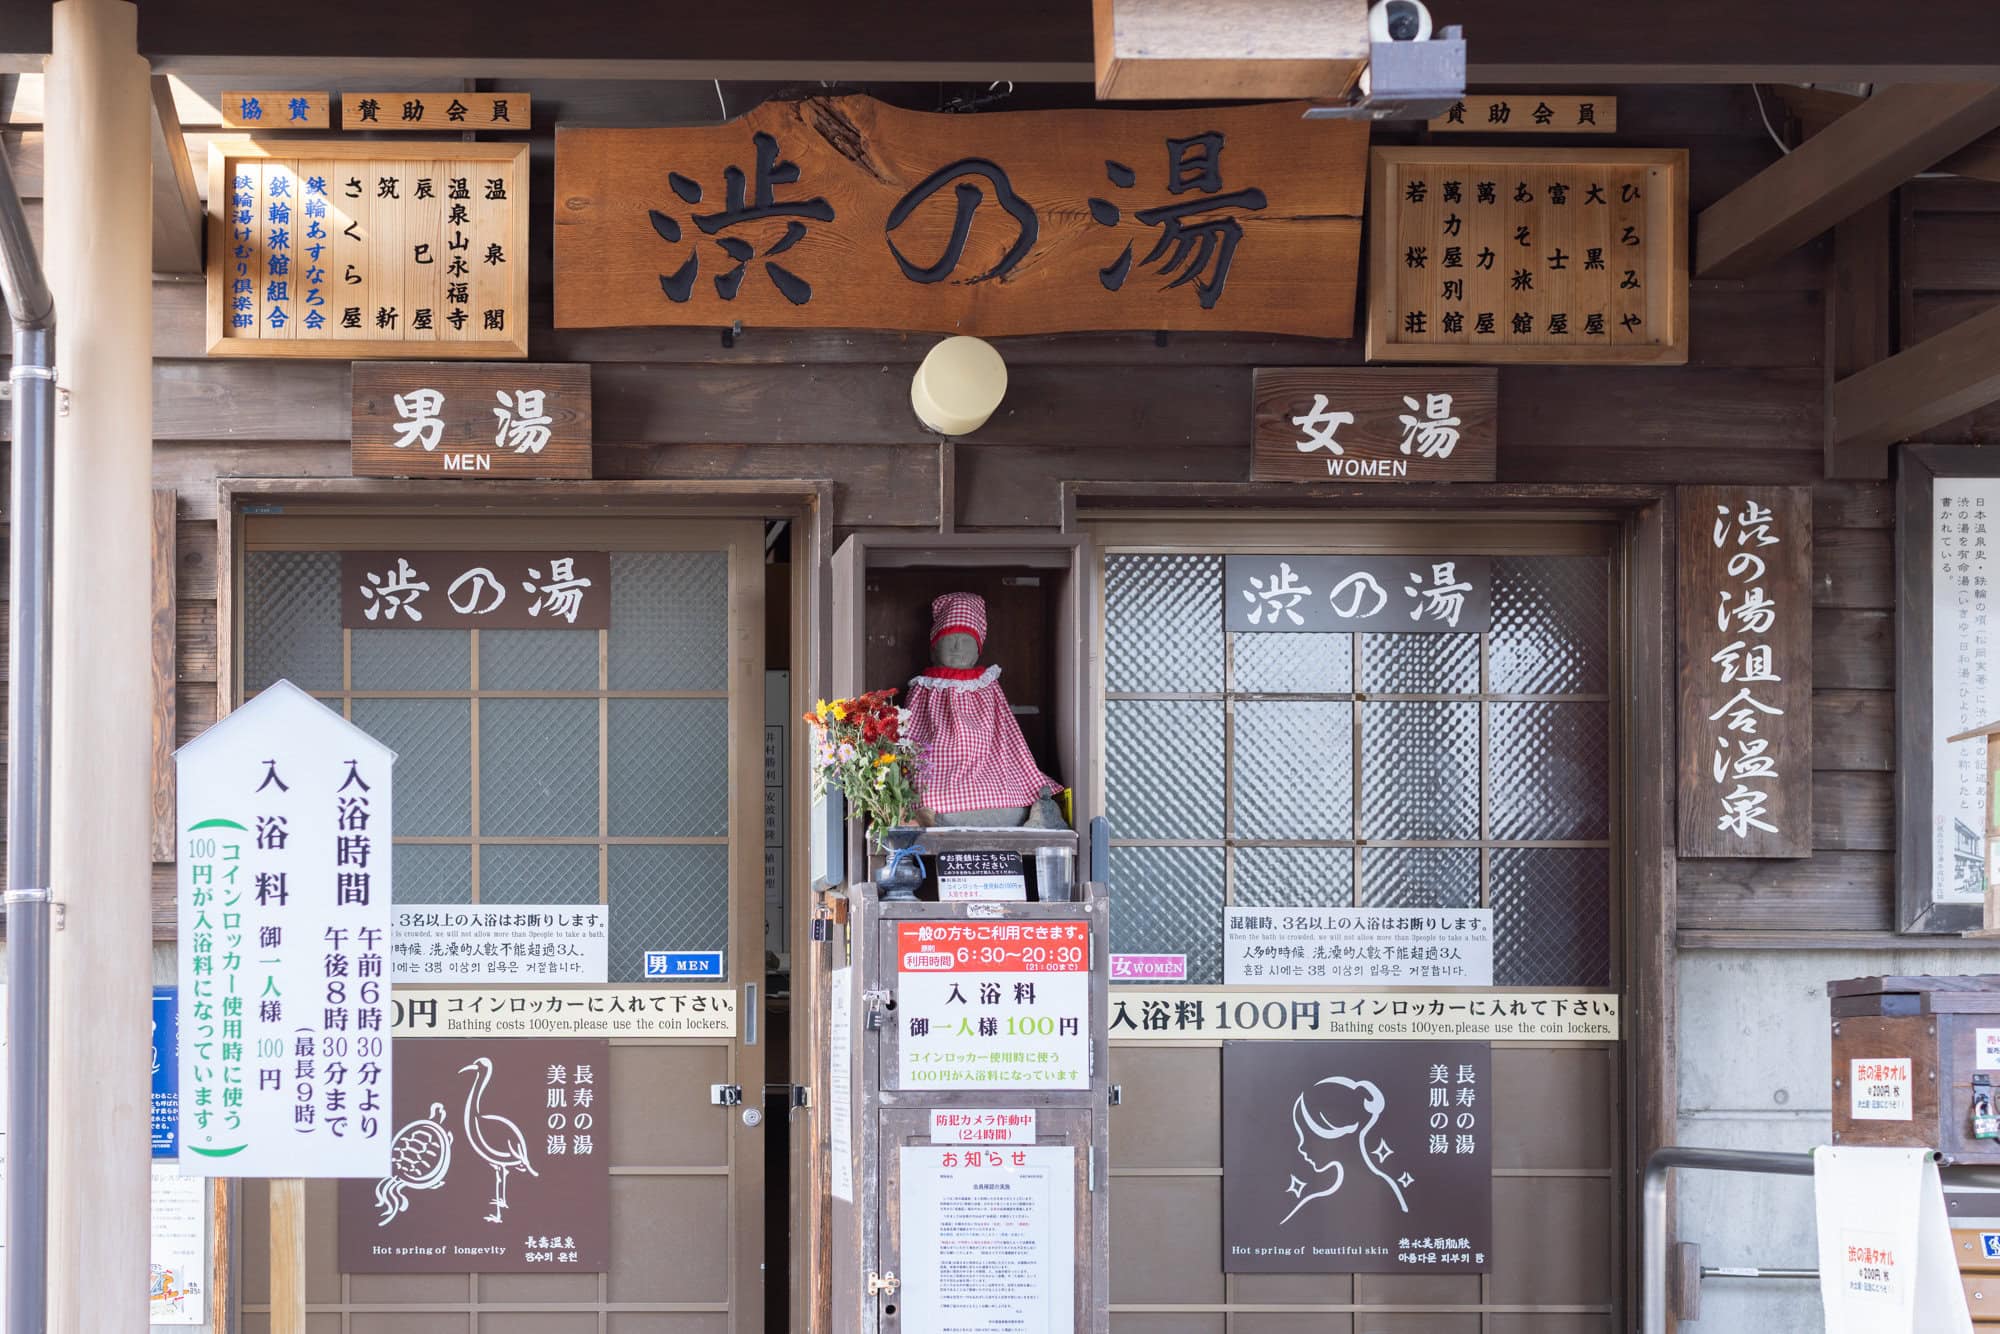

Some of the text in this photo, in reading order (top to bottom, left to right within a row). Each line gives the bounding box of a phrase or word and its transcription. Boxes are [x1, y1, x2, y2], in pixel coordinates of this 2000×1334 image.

[240, 96, 311, 121] 協賛
[357, 98, 511, 122] 賛助会員
[1446, 101, 1598, 126] 賛助会員
[266, 176, 292, 329] 鉄輪旅館組合
[303, 176, 328, 330] 鉄輪あすなろ会
[339, 177, 364, 329] さくら屋
[375, 177, 400, 329] 筑新
[446, 178, 471, 329] 温泉山永福寺
[648, 129, 1269, 310] 渋の湯
[413, 178, 436, 330] 辰巳屋
[483, 178, 508, 331] 温泉閣
[1404, 180, 1429, 334] 若桜荘
[1441, 181, 1465, 334] 萬力屋別館
[1473, 181, 1497, 335] 萬力屋
[1511, 182, 1535, 334] あそ旅館
[1547, 182, 1570, 335] 富士屋
[1583, 183, 1607, 336] 大黒屋
[1619, 183, 1642, 333] ひろみや
[392, 388, 553, 454] 男湯
[1292, 393, 1462, 459] 女湯
[444, 454, 491, 471] MEN
[1326, 460, 1408, 477] WOMEN
[360, 557, 592, 625] 渋の湯
[1243, 561, 1474, 628] 渋の湯
[1708, 500, 1784, 838] 渋の湯組合温泉
[254, 758, 290, 907] 入浴料
[336, 758, 371, 907] 入浴時間
[947, 862, 1009, 870] 入れてください
[449, 962, 481, 973] 이상의
[647, 955, 710, 975] 男 MEN
[903, 925, 1084, 942] 一般の方もご利用できます。
[906, 955, 952, 967] 利用時間
[1112, 958, 1184, 976] 女 WOMEN
[188, 838, 217, 1142] 100円が入浴料になっています。
[221, 843, 243, 1129] コインロッカー使用時に使う
[944, 982, 1036, 1005] 入浴料
[1243, 964, 1263, 976] 혼잡
[1269, 964, 1304, 976] 시에는
[1307, 964, 1326, 976] 3명
[1332, 964, 1364, 976] 이상의
[322, 926, 350, 1139] 午後8時30分まで
[356, 926, 383, 1139] 午前6時30分より
[447, 995, 736, 1014] コインロッカーに入れて下さい。
[447, 1018, 491, 1033] Bathing
[496, 1018, 525, 1030] costs
[613, 1021, 632, 1030] use
[637, 1018, 654, 1030] the
[658, 1018, 682, 1030] coin
[1329, 999, 1616, 1017] コインロッカーに入れて下さい。
[1329, 1021, 1374, 1036] Bathing
[1378, 1021, 1407, 1034] costs
[1494, 1025, 1514, 1034] use
[1518, 1021, 1536, 1034] the
[1540, 1021, 1563, 1034] coin
[294, 1027, 317, 1134] (最長9時)
[909, 1052, 1060, 1064] コインロッカー使用時に使う
[911, 1070, 1079, 1081] 100円が入浴料になっています
[546, 1064, 567, 1155] 美肌の湯
[573, 1064, 594, 1155] 長寿の湯
[935, 1114, 1032, 1127] 防犯カメラ作動中
[958, 1129, 1013, 1141] (24時間)
[1429, 1064, 1449, 1154] 美肌の湯
[1455, 1064, 1476, 1154] 長寿の湯
[942, 1150, 1027, 1168] お知らせ
[372, 1245, 507, 1257] Hot spring of longevity
[1231, 1245, 1390, 1257] Hot spring of beautiful skin
